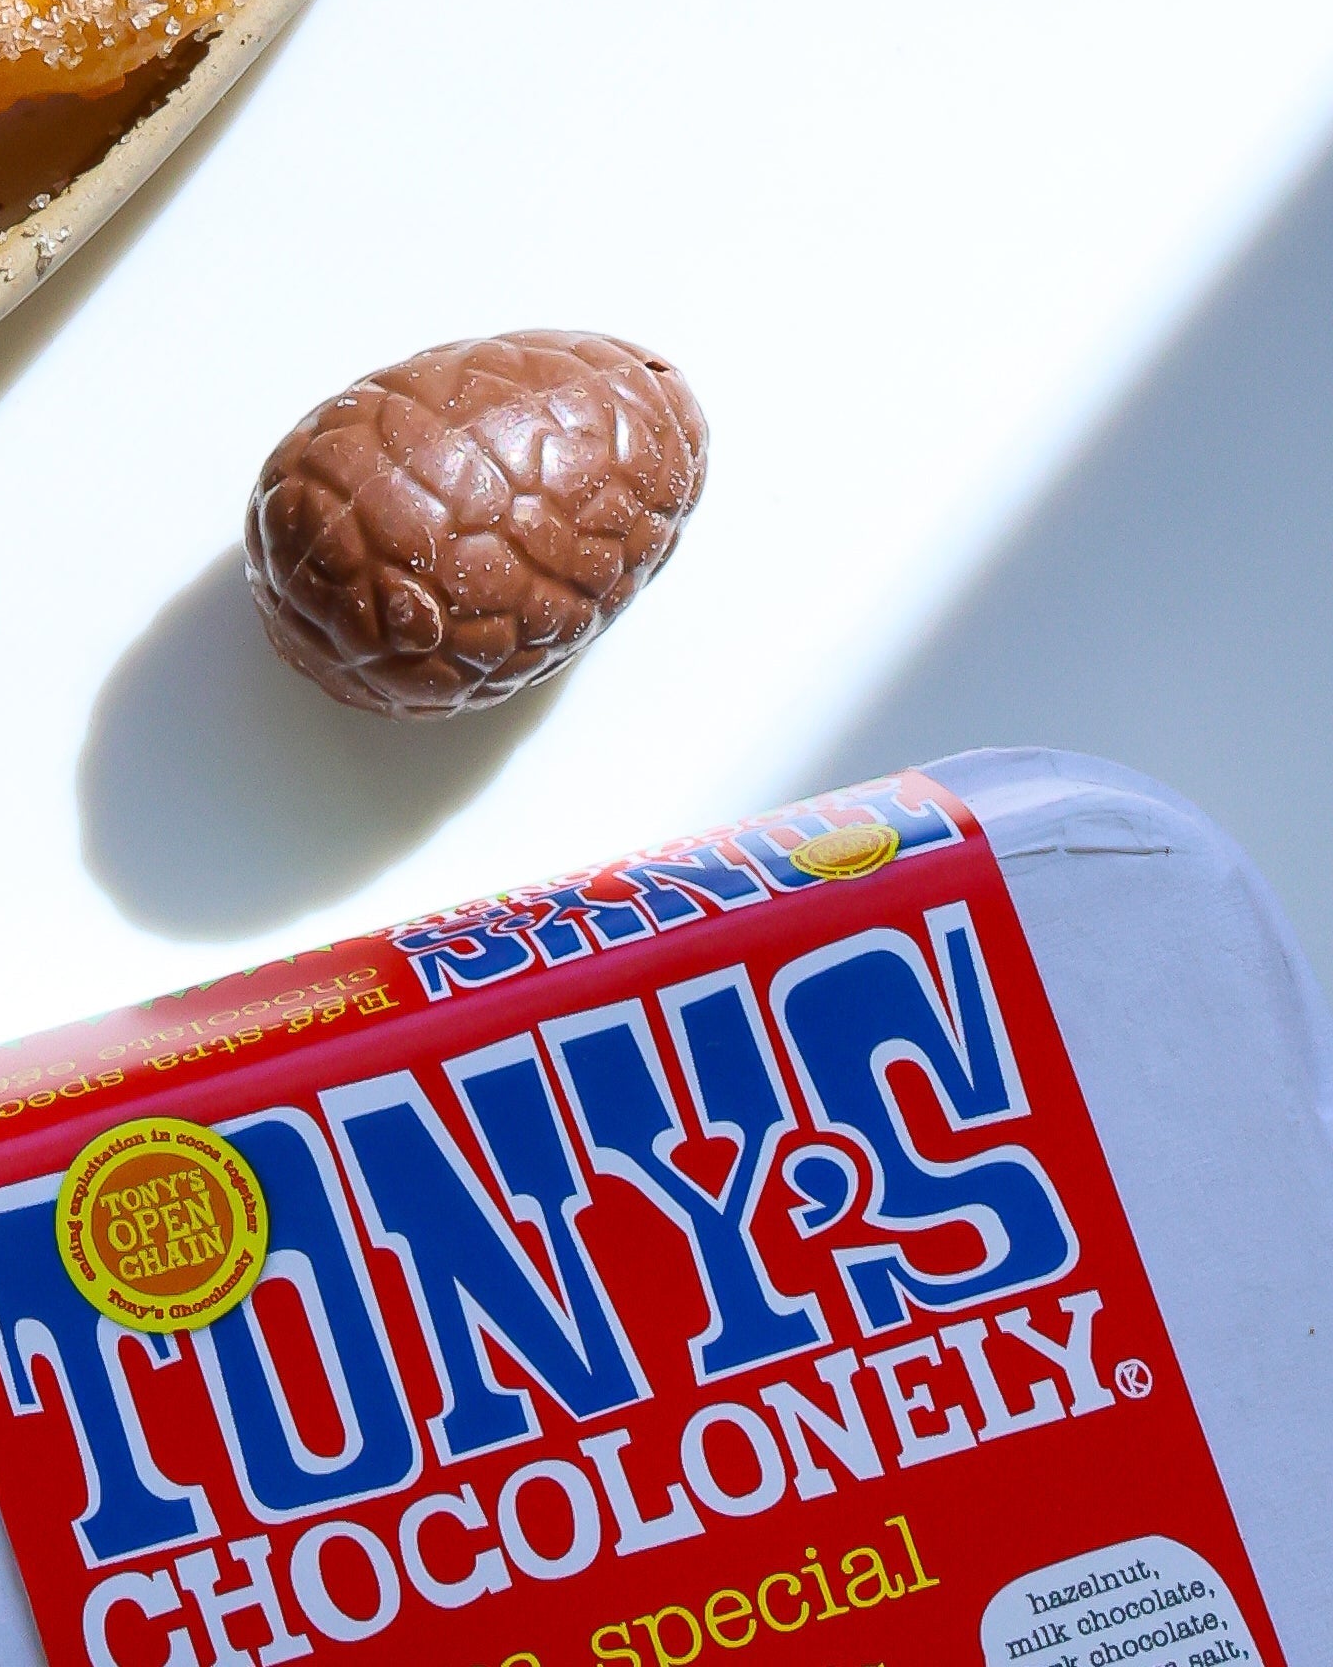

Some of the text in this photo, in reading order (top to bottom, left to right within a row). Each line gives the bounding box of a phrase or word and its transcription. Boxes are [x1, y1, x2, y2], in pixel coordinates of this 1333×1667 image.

[98, 965, 378, 1062] chocolate
[142, 984, 401, 1071] Egg-stra
[150, 1129, 171, 1143] in
[176, 1133, 221, 1162] cocoa
[100, 1167, 206, 1217] TONY'S
[107, 1191, 217, 1253] OPEN
[118, 1225, 226, 1281] CHAIN
[107, 1248, 254, 1320] Tony's Chocolonely
[1026, 1559, 1160, 1615] hazelnut,
[1005, 1577, 1216, 1660] milk chocolate,
[1090, 1611, 1228, 1667] chocolate,
